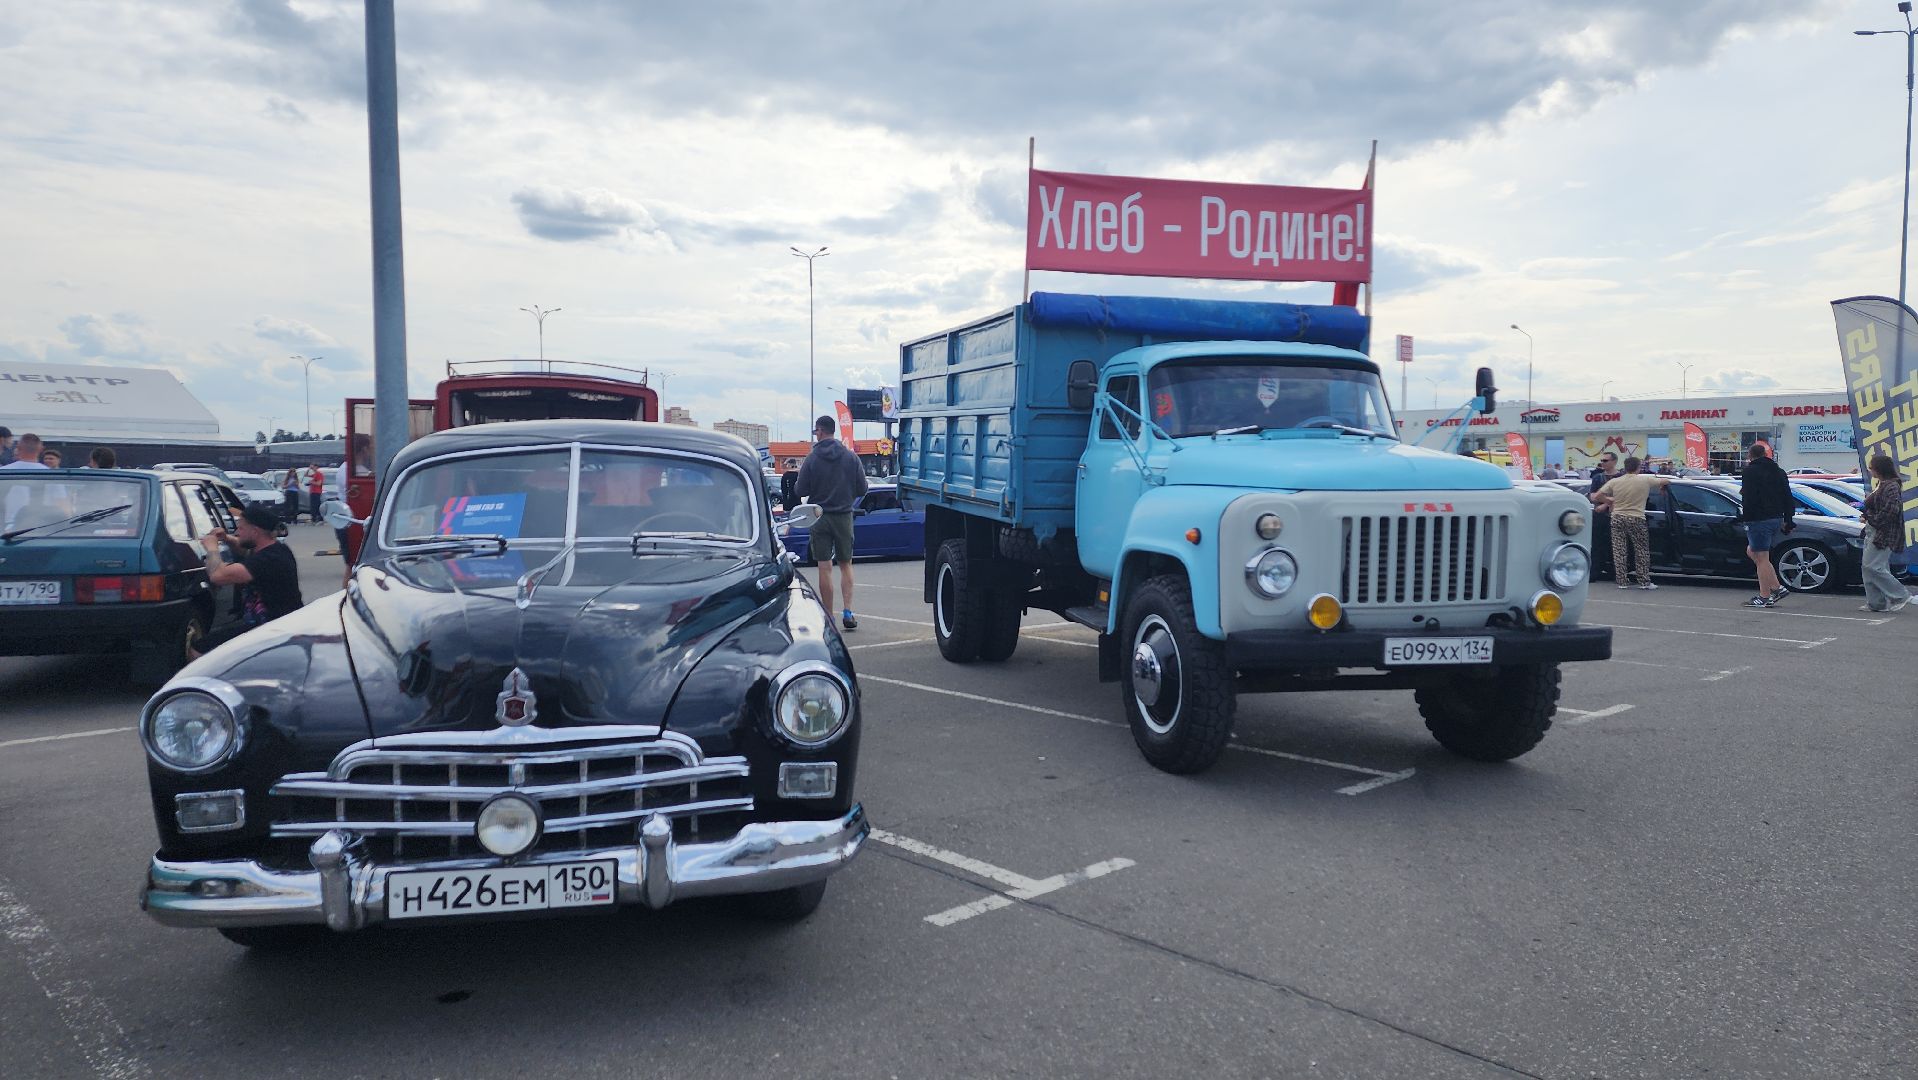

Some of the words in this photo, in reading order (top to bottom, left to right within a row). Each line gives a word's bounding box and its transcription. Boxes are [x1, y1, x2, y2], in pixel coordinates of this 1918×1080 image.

[1037, 185, 1145, 254] Хлеб
[1163, 224, 1182, 232] -
[1200, 195, 1365, 267] Родине!
[1520, 415, 1560, 424] ДОМИКС
[1585, 412, 1621, 423] ОБОИ
[1660, 409, 1728, 420] ЛАМИНАТ
[1426, 416, 1499, 427] СНТЕНИКА
[1799, 435, 1837, 443] КРАСКИ
[0, 586, 25, 599] ТУ
[29, 582, 56, 594] 790
[1464, 640, 1490, 655] 134
[402, 874, 546, 913] Н426ЕМ
[554, 866, 605, 893] 150
[564, 891, 591, 903] RUS
